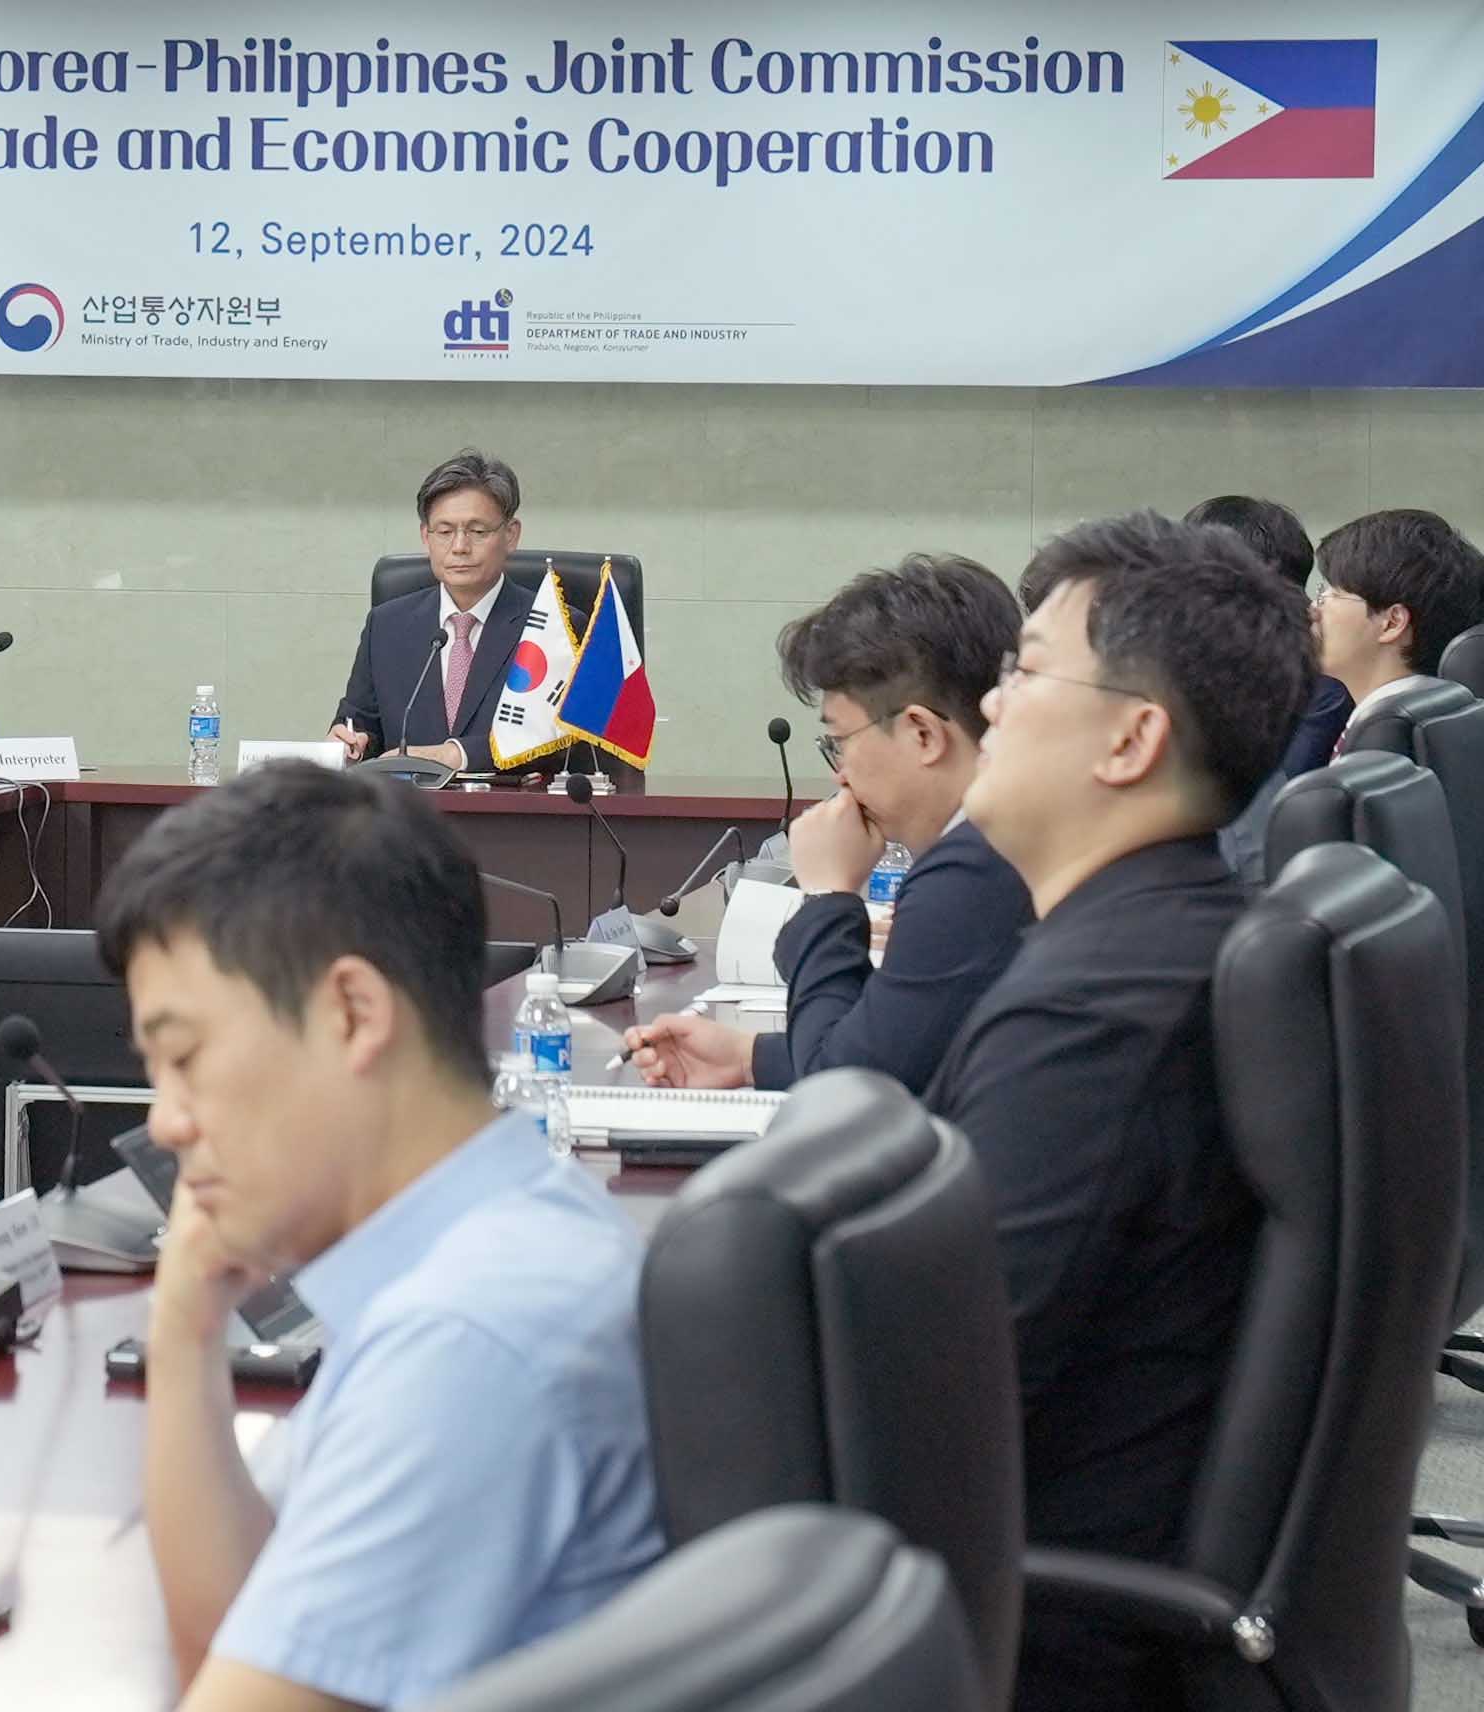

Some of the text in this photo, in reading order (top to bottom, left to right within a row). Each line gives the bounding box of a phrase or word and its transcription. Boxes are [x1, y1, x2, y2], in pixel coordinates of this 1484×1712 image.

[525, 36, 694, 95] Joint
[710, 36, 1124, 95] Commission
[117, 116, 231, 172] and
[249, 116, 569, 174] Economic
[588, 116, 993, 188] Cooperation
[189, 221, 595, 263] 12, September, 2024
[82, 295, 282, 327] 산업통상자원부
[443, 288, 514, 341] dti
[526, 311, 642, 322] Republic of the Philippines
[81, 333, 328, 352] Ministry of Trade, Industry and Energy
[526, 328, 748, 341] DEPARTMENT OF TRADE AND INDUSTRY
[0, 753, 68, 768] Interpreter
